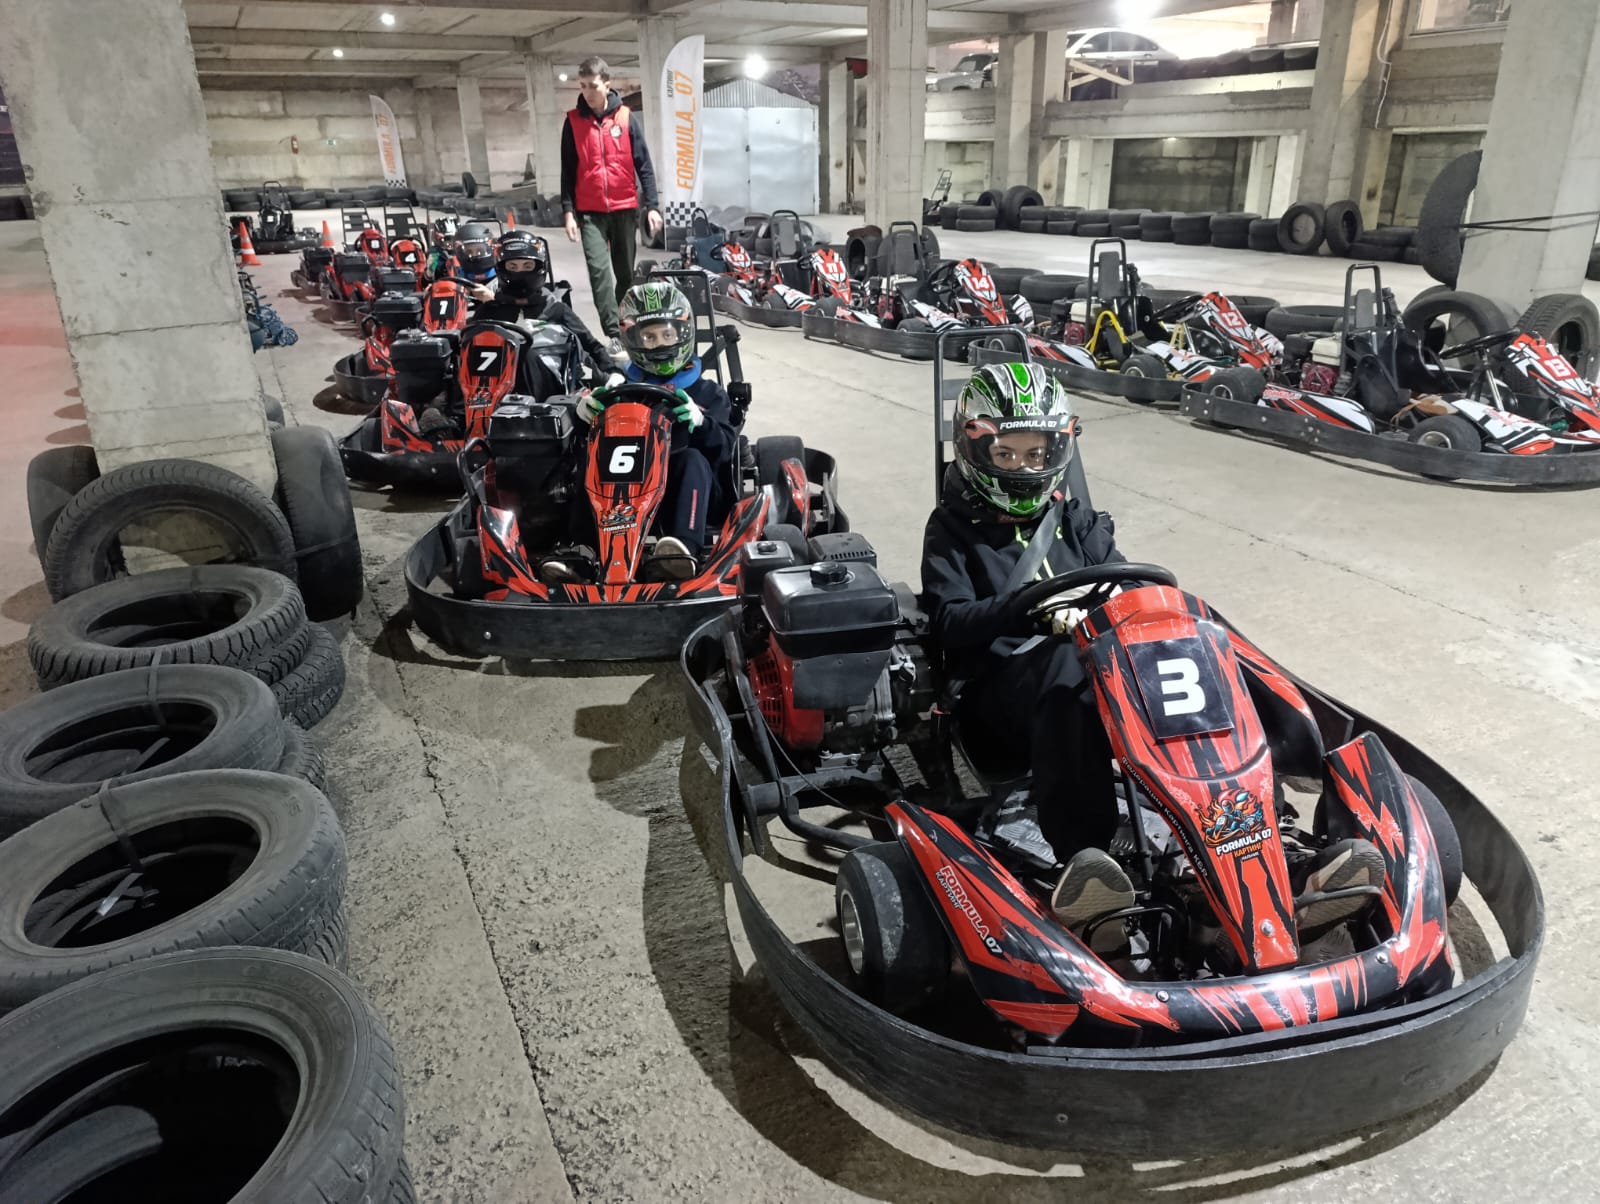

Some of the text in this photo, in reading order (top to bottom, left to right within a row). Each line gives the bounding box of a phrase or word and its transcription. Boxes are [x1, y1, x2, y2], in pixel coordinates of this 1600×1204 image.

[405, 252, 416, 263] 4
[972, 277, 990, 290] 14
[440, 301, 448, 315] 1
[1222, 312, 1242, 327] 12
[477, 351, 498, 371] 7
[1000, 419, 1057, 430] FORMULA 07
[609, 445, 639, 474] 6
[1157, 657, 1206, 716] 3
[1164, 807, 1193, 853] Картинга
[1215, 828, 1272, 855] FORMULA 07
